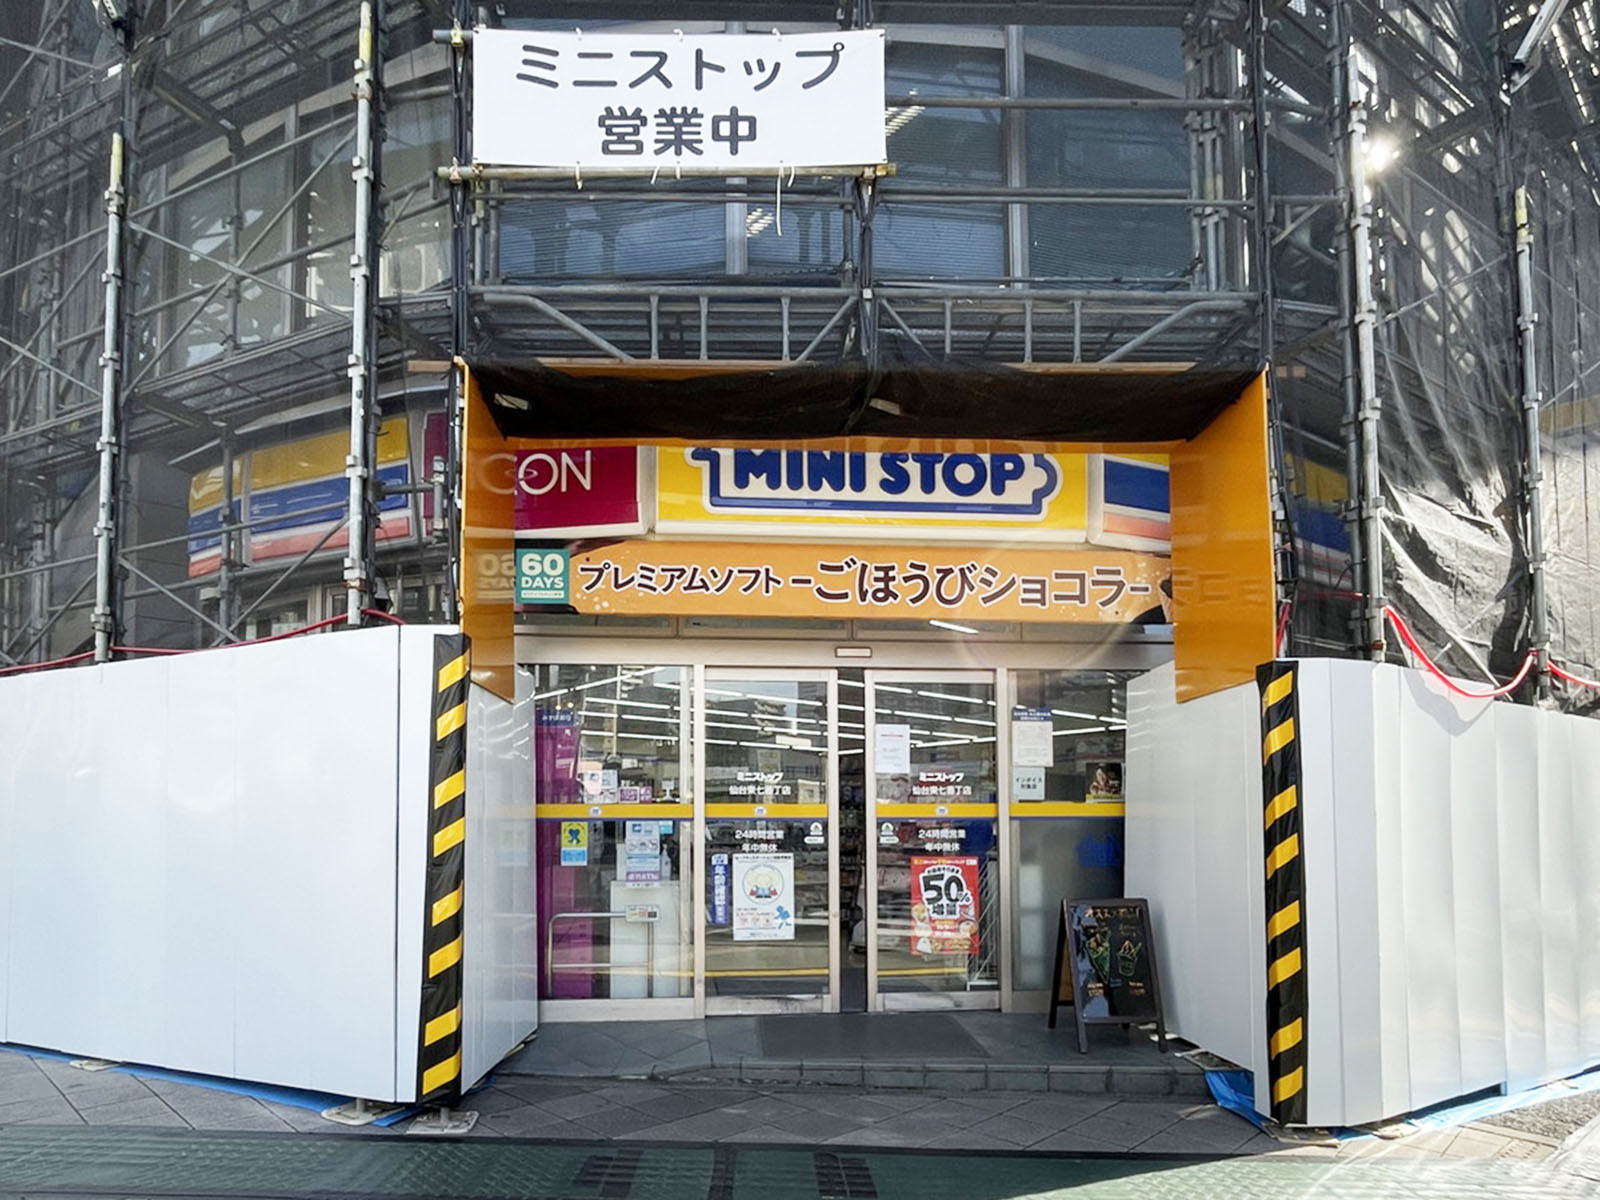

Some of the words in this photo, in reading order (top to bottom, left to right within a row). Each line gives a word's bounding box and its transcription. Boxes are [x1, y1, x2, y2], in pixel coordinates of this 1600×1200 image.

[515, 41, 845, 92] ミニストップ
[598, 105, 758, 156] 営業中
[734, 448, 866, 493] MINI
[880, 452, 1025, 498] STOP
[521, 552, 565, 577] 60
[521, 576, 565, 589] DAYS
[921, 873, 971, 905] 50%
